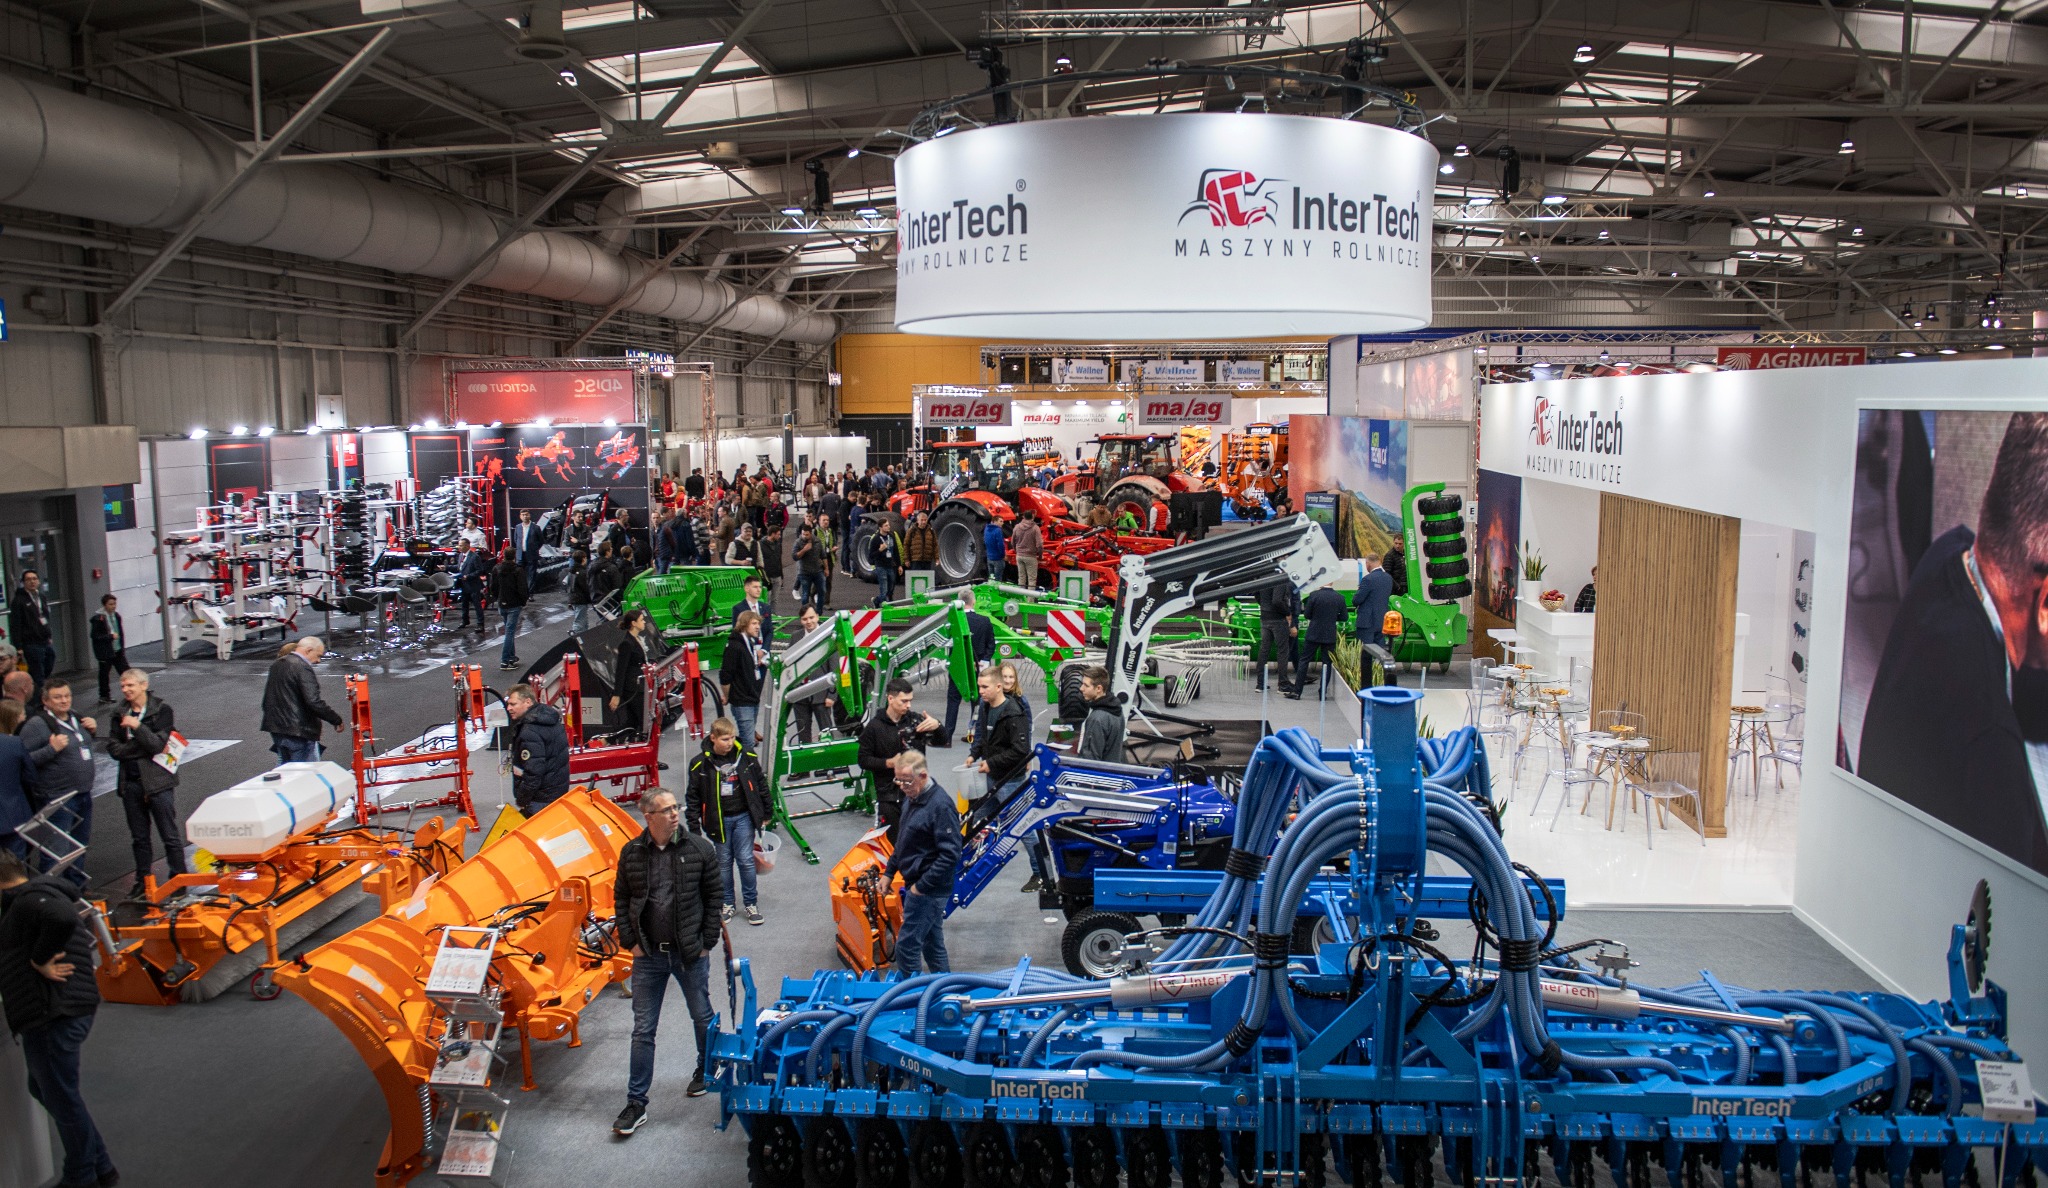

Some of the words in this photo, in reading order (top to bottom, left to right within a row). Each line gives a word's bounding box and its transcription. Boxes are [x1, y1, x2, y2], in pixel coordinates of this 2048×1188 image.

[908, 193, 1028, 250] InterTech
[1293, 186, 1420, 243] InterTech
[923, 244, 1028, 271] ROLNICZE
[1175, 238, 1312, 257] MASZYNY
[1333, 240, 1419, 268] ROLNICZE
[1076, 365, 1103, 374] Wallner
[1237, 366, 1260, 375] Wallner
[1757, 352, 1859, 368] AGRIMET
[1557, 410, 1623, 456] InterTech
[1526, 454, 1563, 476] MASZYNY
[1569, 460, 1622, 484] ROLNICZE
[1132, 595, 1156, 630] InterTech
[1001, 646, 1011, 654] 30
[193, 823, 254, 838] InterTech
[341, 849, 358, 857] 2.00
[900, 1055, 920, 1073] 6.00
[922, 1067, 932, 1078] m
[991, 1079, 1086, 1099] InterTech
[1856, 1081, 1873, 1096] 6.00
[1874, 1076, 1884, 1086] m
[1692, 1096, 1792, 1117] InterTech
